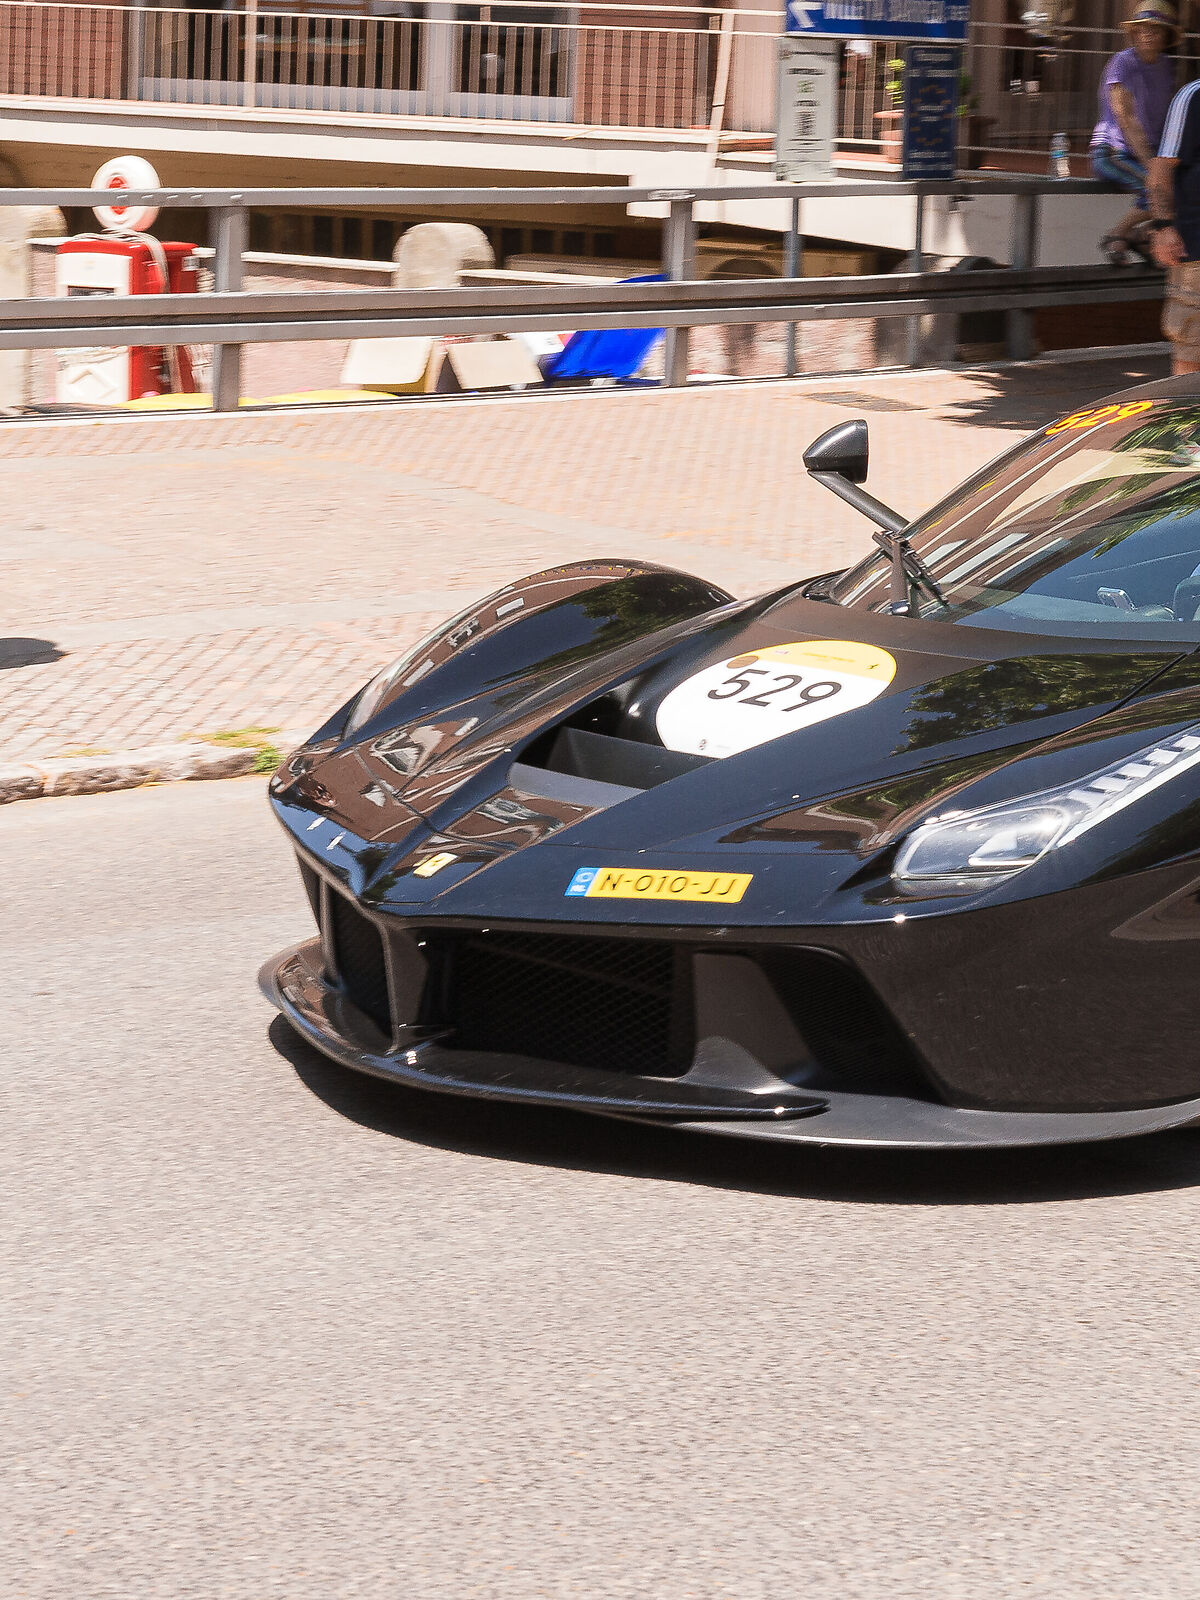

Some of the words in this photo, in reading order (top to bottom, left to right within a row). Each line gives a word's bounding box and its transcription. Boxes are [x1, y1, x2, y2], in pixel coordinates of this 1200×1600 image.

[1045, 401, 1154, 435] 529
[707, 668, 842, 712] 529
[601, 872, 738, 896] N-010-JJ
